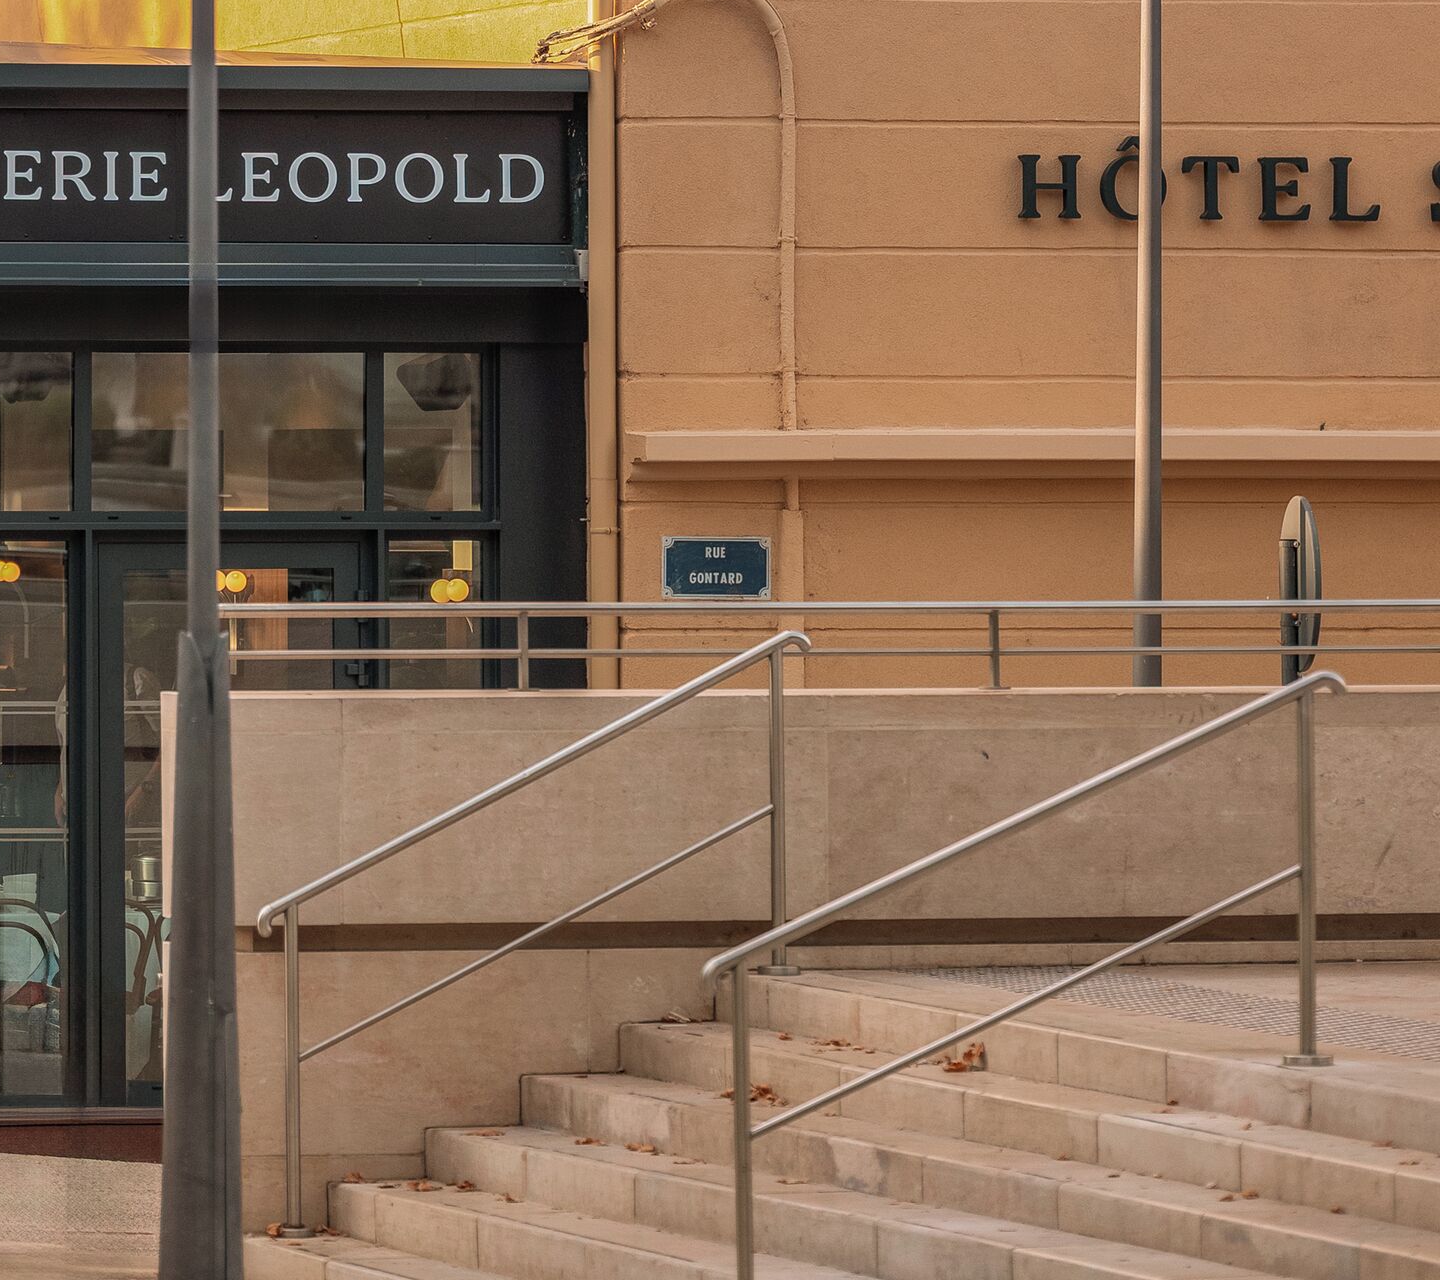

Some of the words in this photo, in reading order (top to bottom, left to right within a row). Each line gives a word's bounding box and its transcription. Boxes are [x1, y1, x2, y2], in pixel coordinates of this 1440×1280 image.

[215, 150, 546, 204] EOPOLD
[1017, 135, 1380, 222] HÔTEL
[705, 546, 726, 559] RUE
[689, 572, 743, 584] GONTARD
